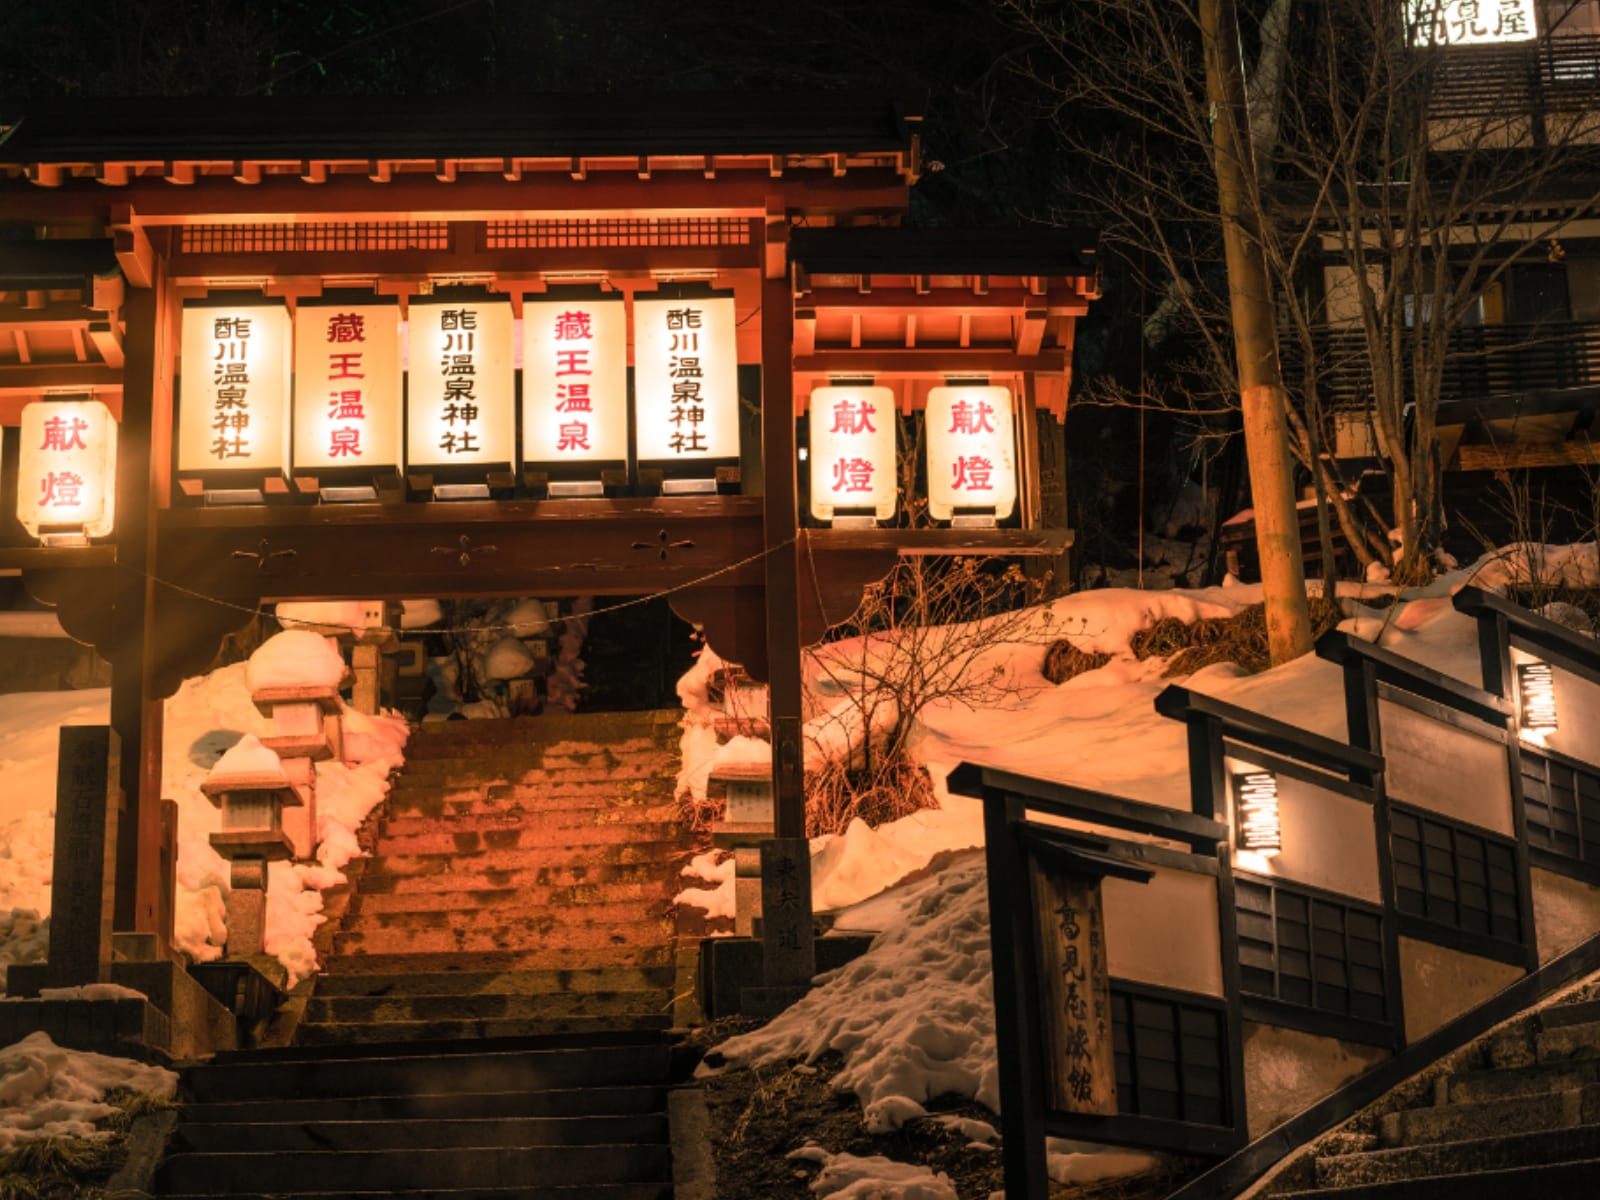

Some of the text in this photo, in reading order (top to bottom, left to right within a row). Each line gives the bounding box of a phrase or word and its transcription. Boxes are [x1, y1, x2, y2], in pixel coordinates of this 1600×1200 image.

[1408, 0, 1529, 41] 見屋
[327, 313, 366, 457] 蔵王温泉
[554, 310, 593, 451] 蔵王温泉
[38, 416, 88, 507] 献燈
[830, 399, 877, 492] 献燈
[948, 400, 995, 491] 献燈
